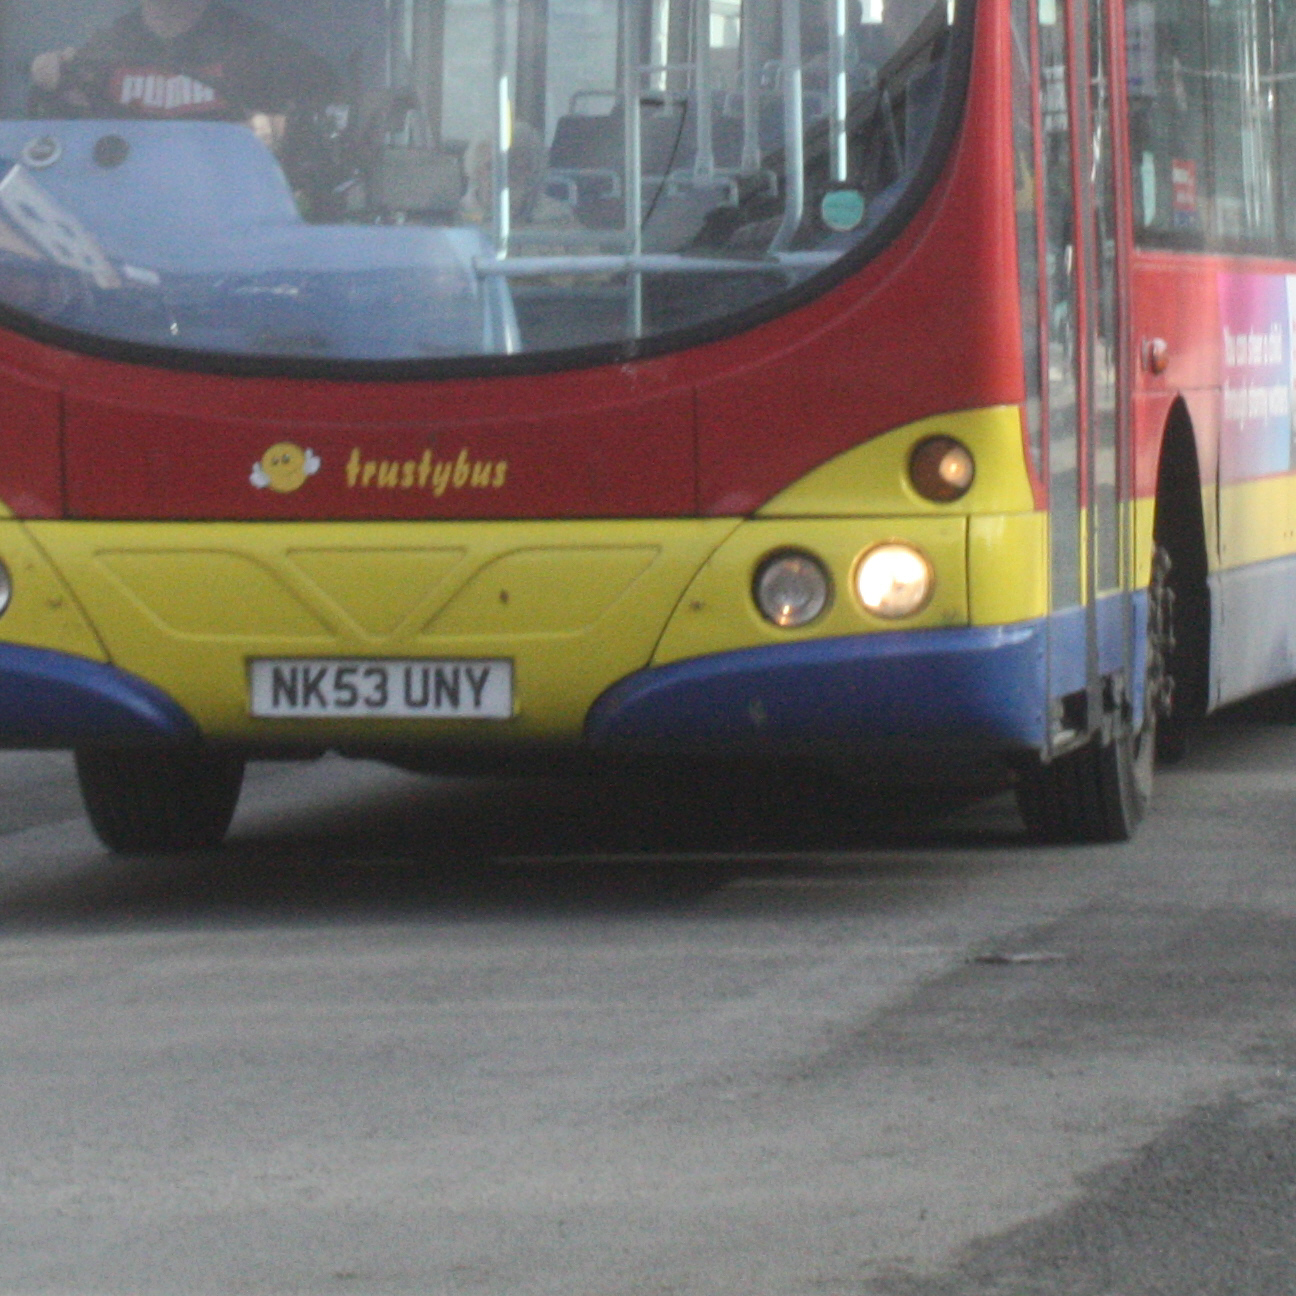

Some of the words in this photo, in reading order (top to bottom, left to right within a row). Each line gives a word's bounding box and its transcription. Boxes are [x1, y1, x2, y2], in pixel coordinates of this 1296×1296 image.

[346, 446, 506, 498] trustybus
[272, 665, 389, 708] NK53
[404, 665, 491, 708] UNY
